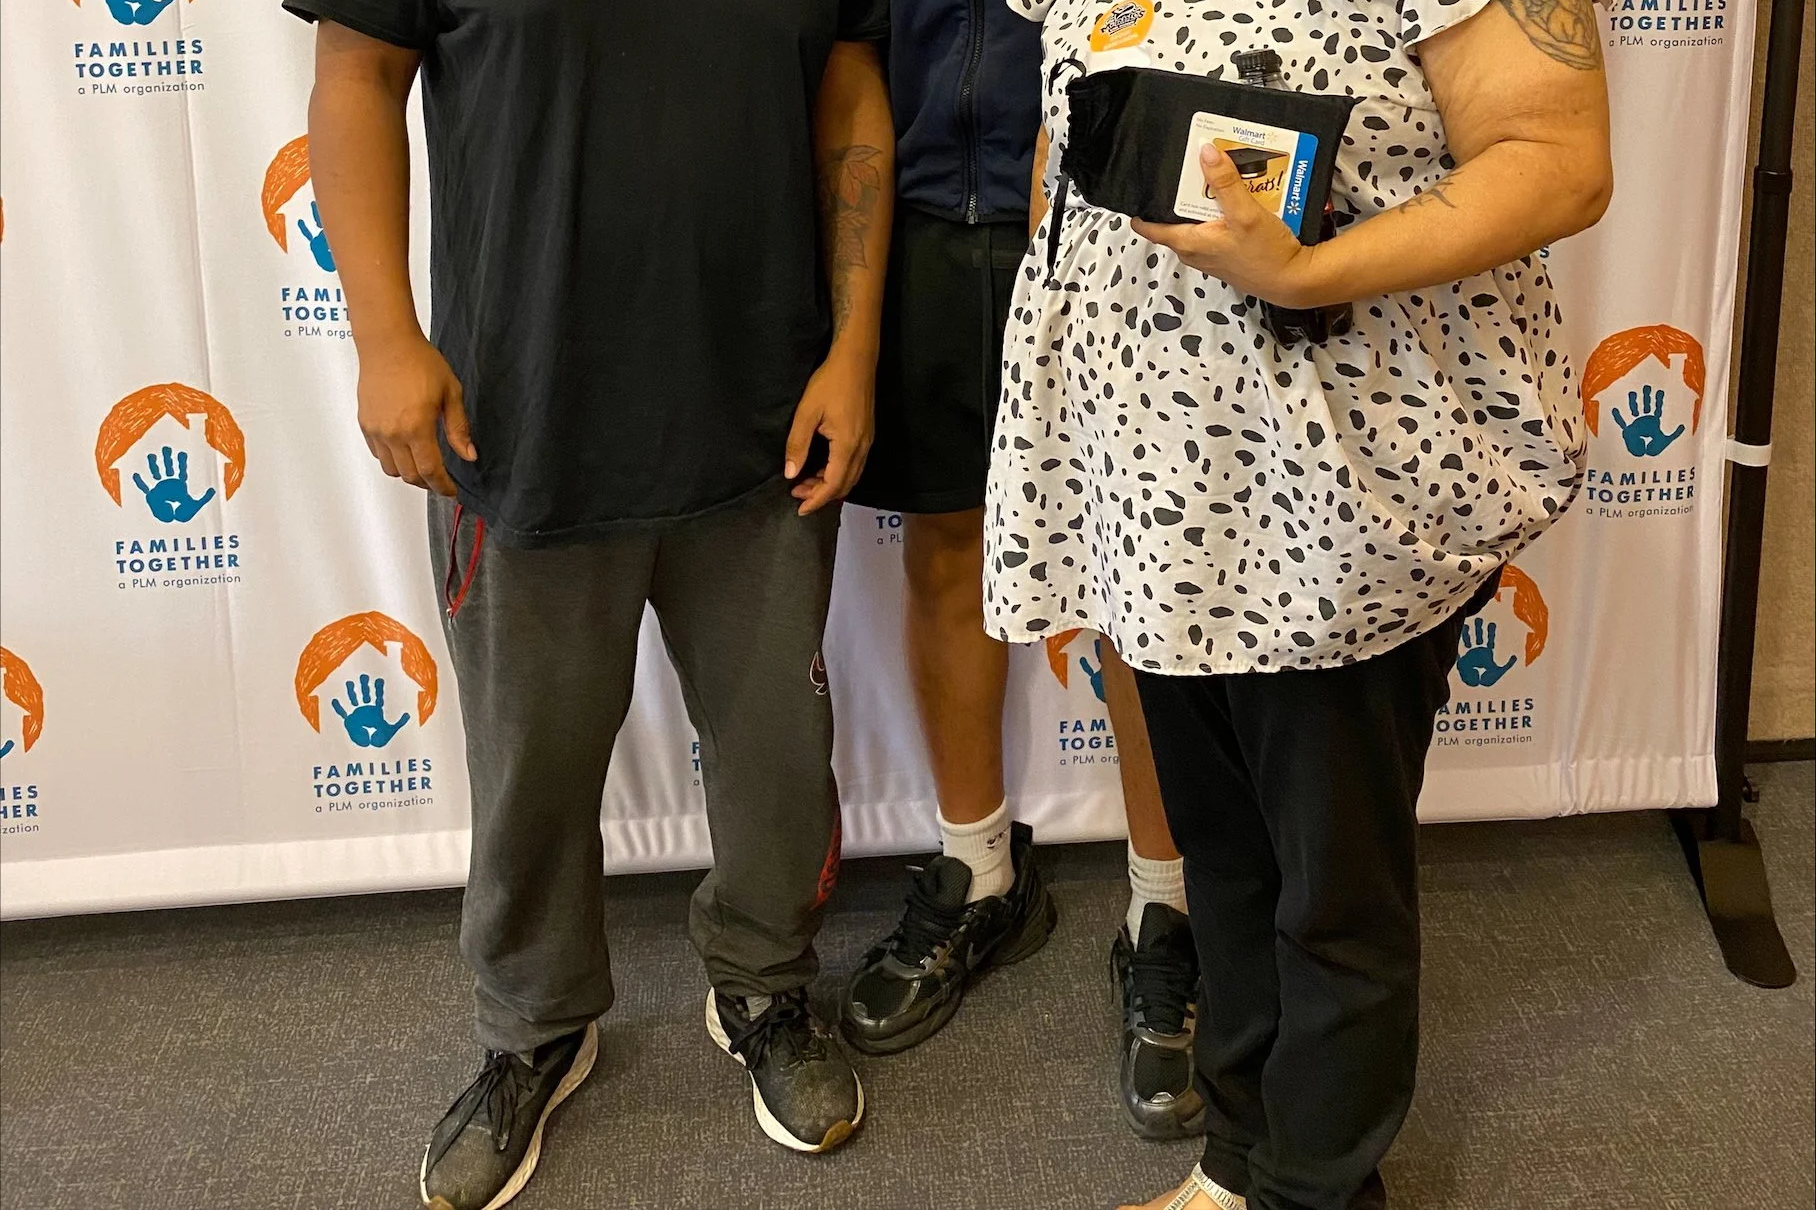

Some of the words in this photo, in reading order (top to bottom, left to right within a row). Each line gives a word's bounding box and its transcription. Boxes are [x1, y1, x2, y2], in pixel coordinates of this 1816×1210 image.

[1610, 15, 1724, 31] TOGETHER
[74, 40, 203, 58] FAMILIES
[1609, 39, 1615, 47] a
[1619, 36, 1644, 47] PLM
[1650, 35, 1723, 48] organization
[75, 60, 203, 78] TOGETHER
[78, 86, 86, 95] a
[92, 82, 118, 94] PLM
[123, 82, 205, 96] organization
[1232, 126, 1266, 139] Walmart
[1290, 160, 1309, 201] Walmart
[281, 287, 341, 302] FAMI
[282, 307, 350, 321] TOGET
[284, 329, 292, 338] a
[298, 326, 322, 337] PLM
[1587, 466, 1695, 486] FAMILIES
[1586, 486, 1695, 503] TOGETHER
[1586, 507, 1593, 515] a
[1599, 507, 1623, 518] PLM
[115, 535, 240, 555] FAMILIES
[877, 537, 883, 545] a
[890, 534, 904, 544] PL
[116, 554, 240, 573] TOGETHER
[118, 580, 126, 590] a
[132, 576, 157, 589] PLM
[162, 574, 242, 588] organization
[1438, 698, 1534, 716] AMILIES
[1436, 715, 1532, 732] OGETHER
[1059, 737, 1114, 751] TOGE
[1437, 736, 1460, 746] PLM
[1464, 734, 1532, 746] organization
[313, 758, 432, 779] FAMILIES
[1059, 758, 1067, 766] a
[1073, 755, 1095, 765] PLM
[314, 776, 432, 797] TOGETHER
[693, 778, 700, 787] a
[315, 804, 322, 812] a
[329, 800, 353, 812] PLM
[358, 796, 434, 810] organization
